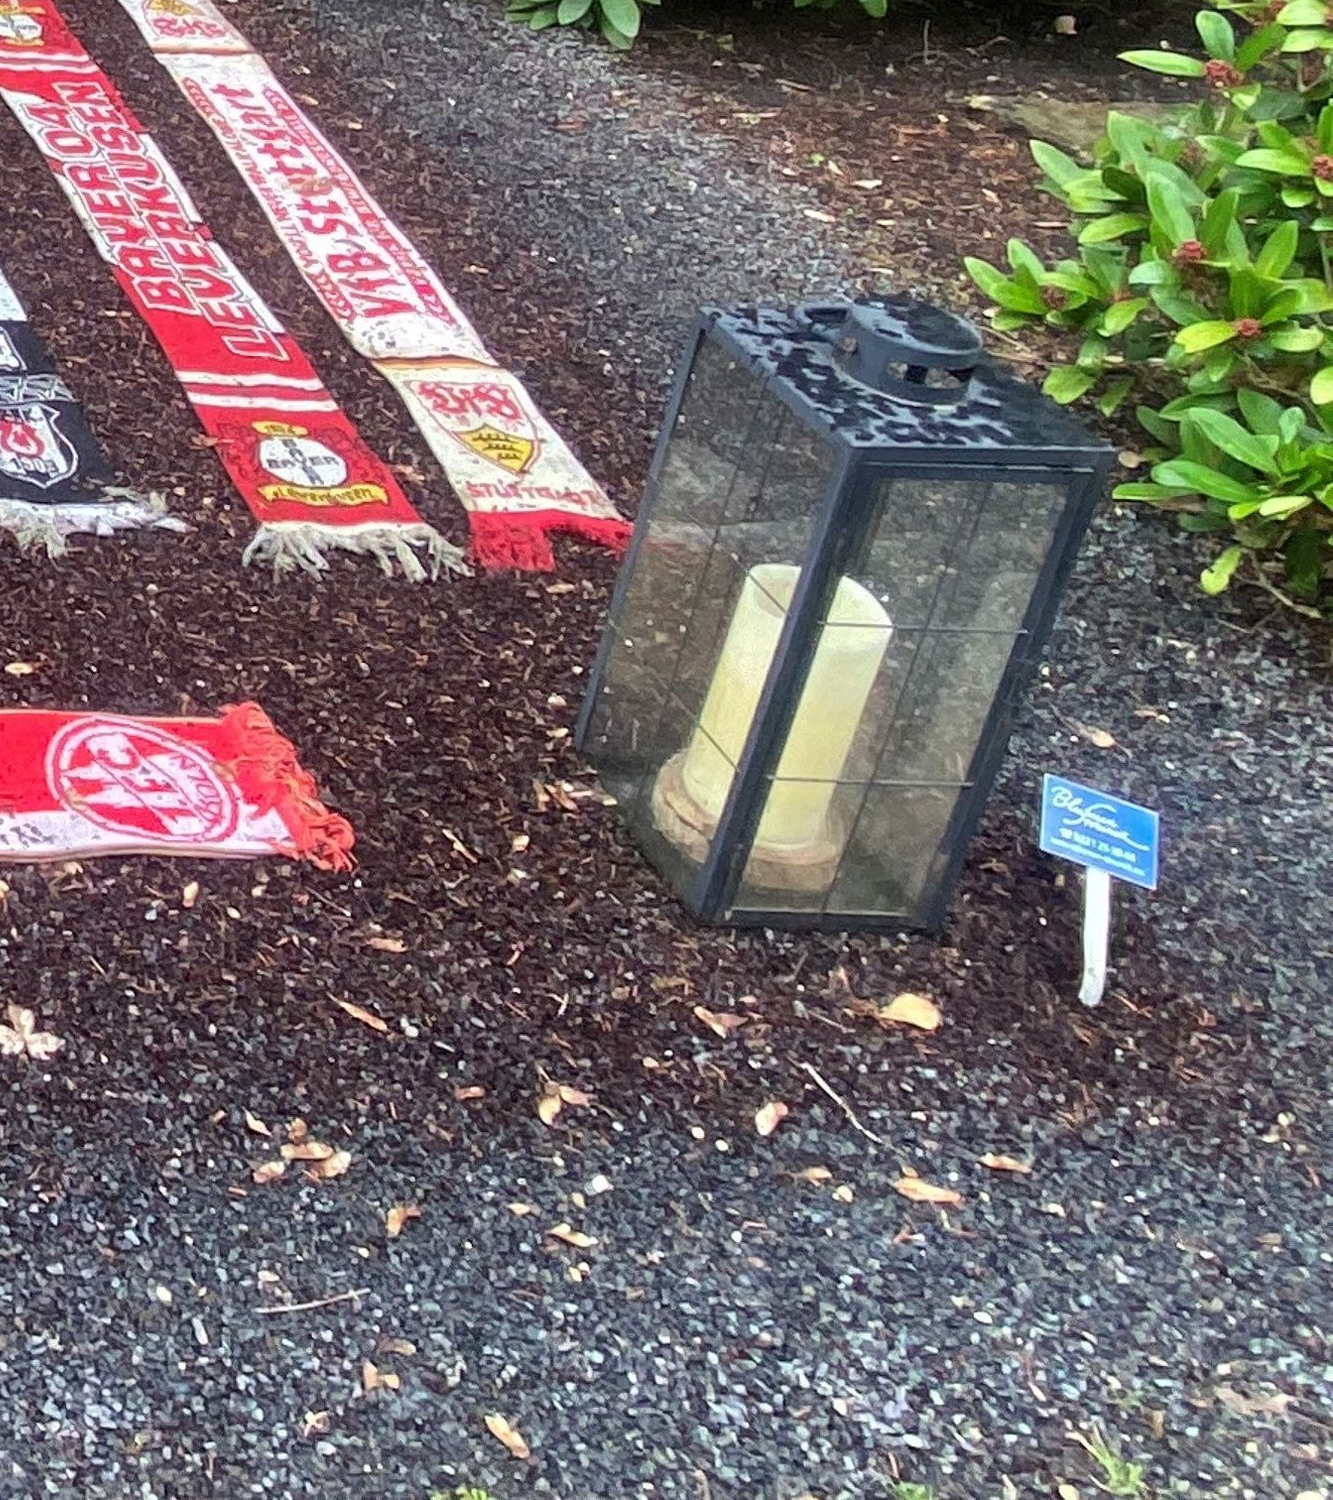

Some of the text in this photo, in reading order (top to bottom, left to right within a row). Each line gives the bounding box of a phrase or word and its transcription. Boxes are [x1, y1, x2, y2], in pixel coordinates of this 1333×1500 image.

[21, 102, 201, 315] BAYER 04
[53, 82, 290, 361] LEVERKUSEN
[325, 252, 416, 318] VfB
